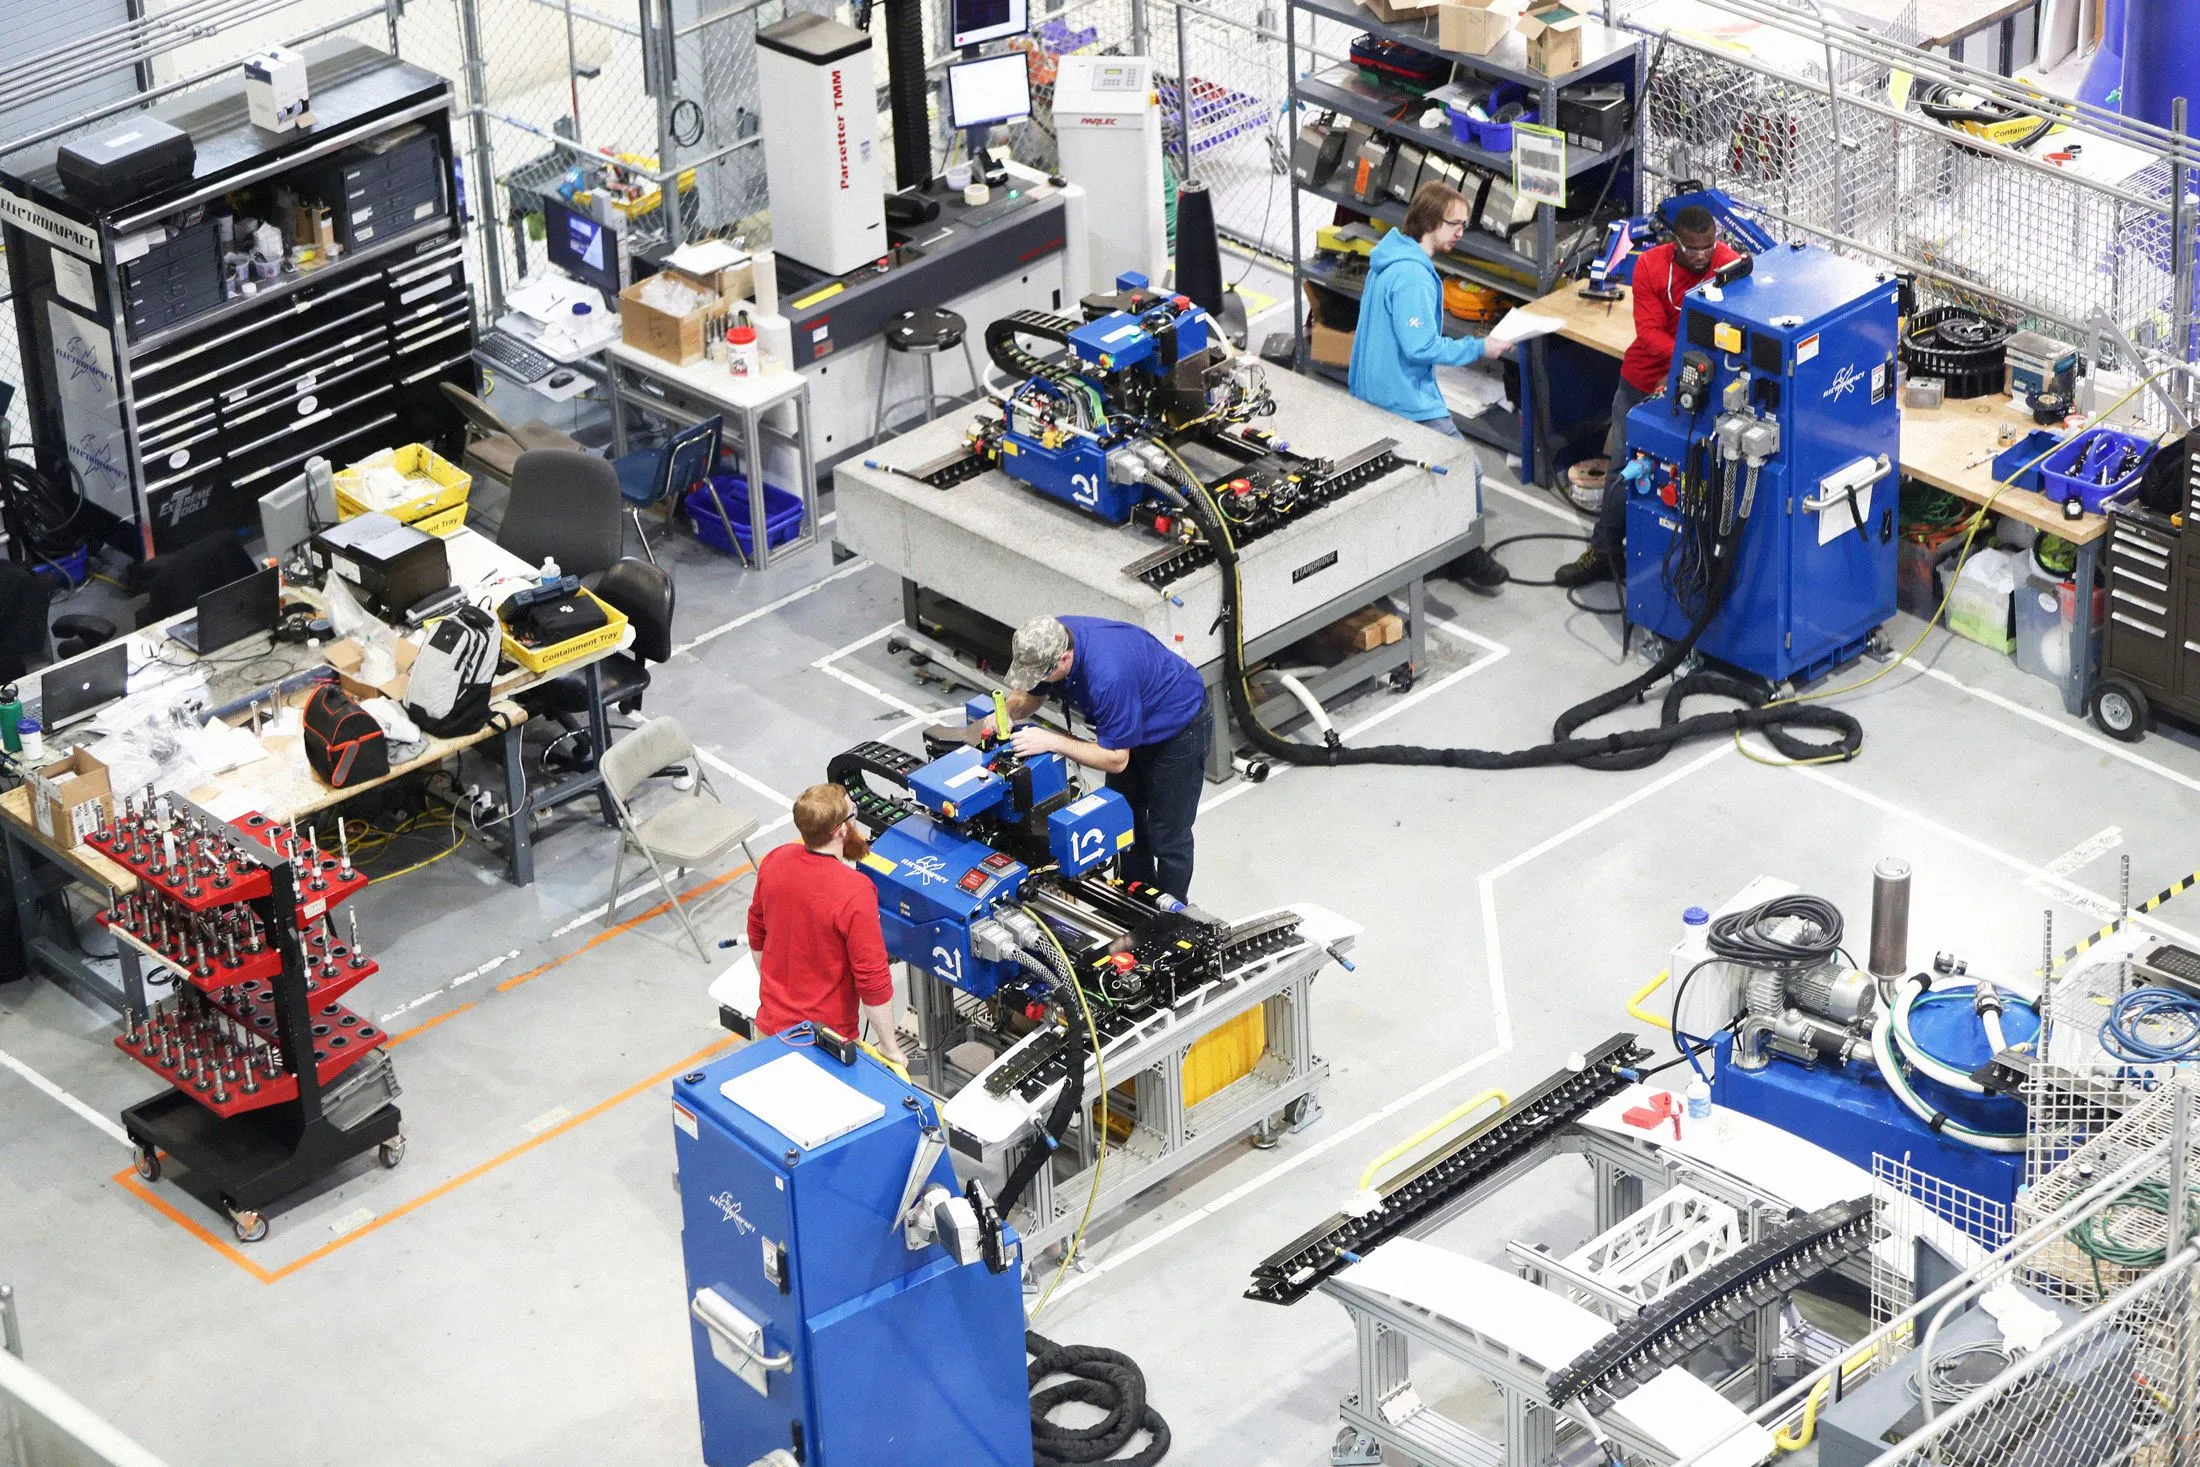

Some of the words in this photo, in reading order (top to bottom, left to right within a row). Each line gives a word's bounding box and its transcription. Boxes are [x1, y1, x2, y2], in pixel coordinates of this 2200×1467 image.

[832, 70, 843, 110] TMM
[1993, 125, 2039, 138] Containme
[838, 115, 850, 190] Parsetter
[0, 198, 95, 250] ELECTROIMPACT
[56, 347, 114, 383] ELECTROIMPACT
[69, 444, 128, 480] ELECTROIMPACT
[442, 517, 458, 528] Tray
[1294, 553, 1335, 580] STANDRIDGE
[542, 638, 597, 663] Containment
[600, 631, 618, 642] Tray
